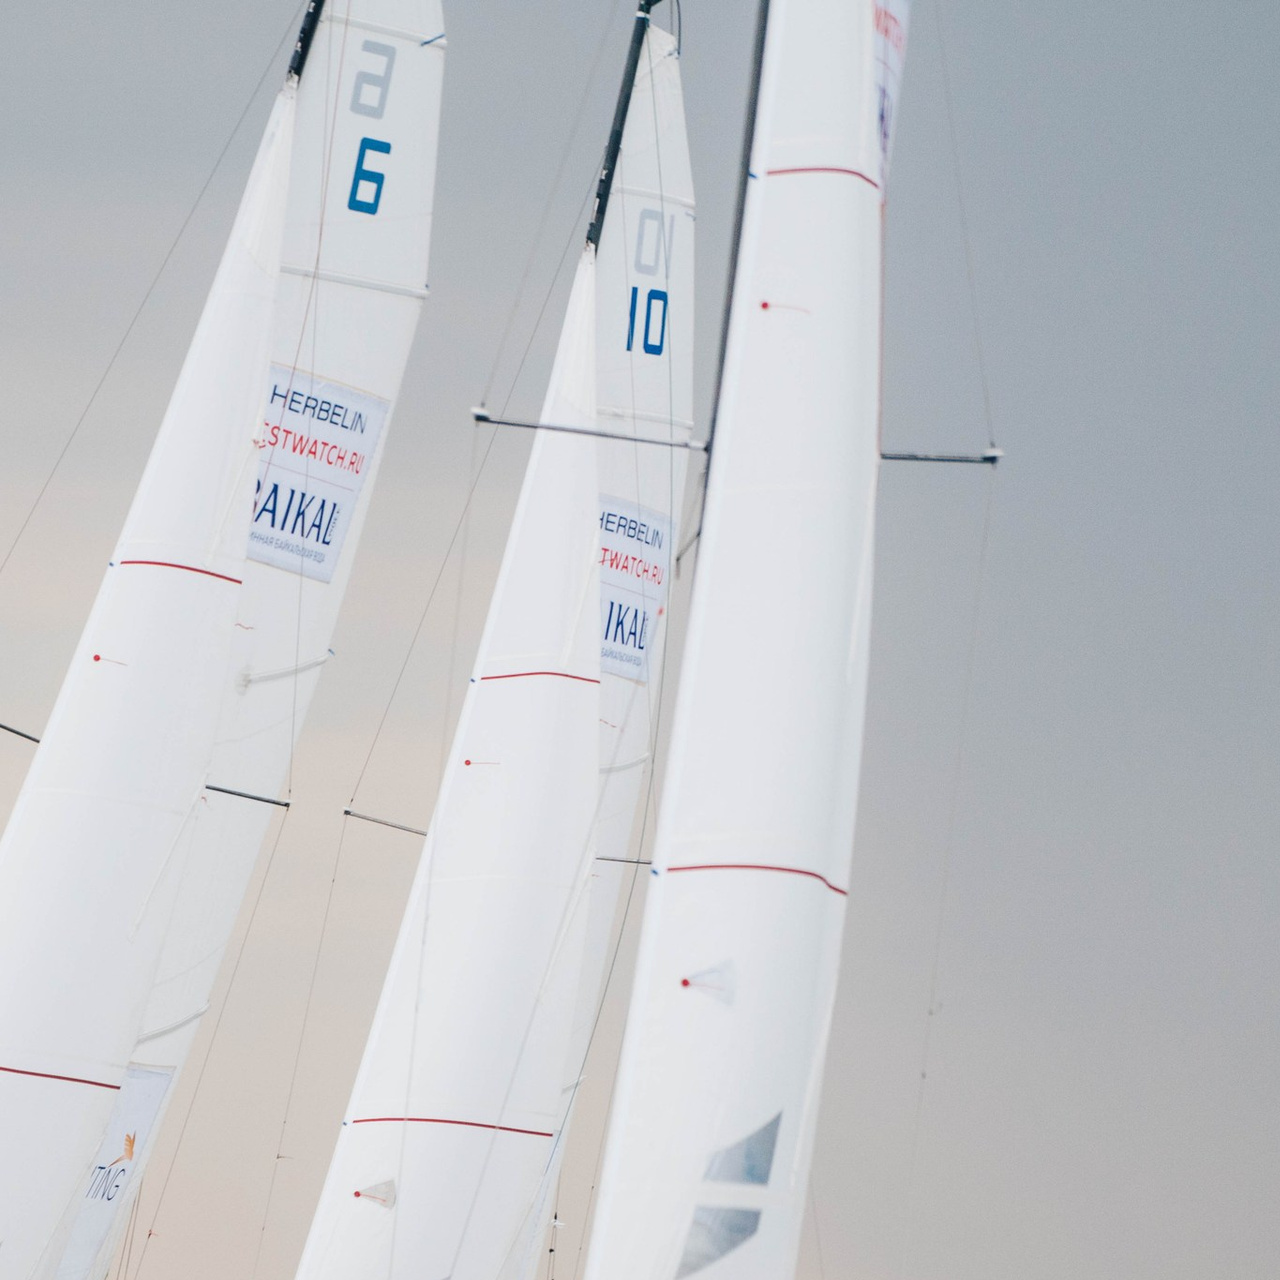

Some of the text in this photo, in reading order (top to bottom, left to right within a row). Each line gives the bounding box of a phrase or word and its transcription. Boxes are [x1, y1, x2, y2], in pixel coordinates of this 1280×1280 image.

[347, 137, 392, 215] 6
[626, 286, 668, 356] 10
[270, 384, 368, 435] HERBELIN
